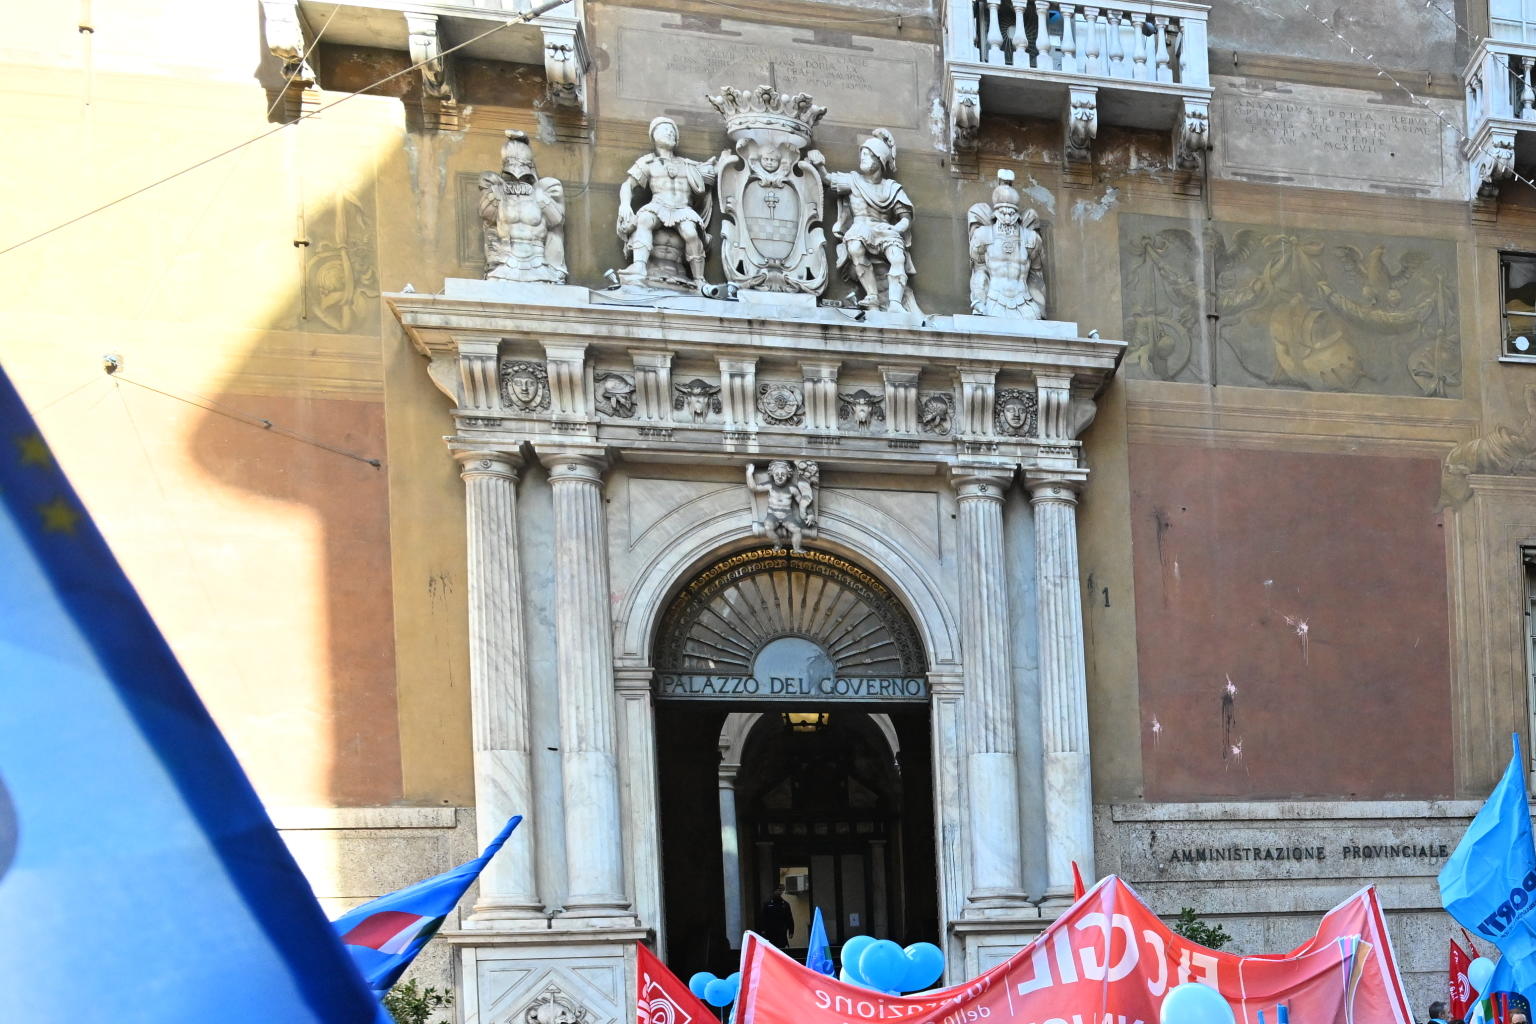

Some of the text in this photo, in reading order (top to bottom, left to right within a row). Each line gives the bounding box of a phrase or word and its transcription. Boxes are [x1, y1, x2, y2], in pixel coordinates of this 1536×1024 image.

[1328, 108, 1374, 121] DORIA
[663, 676, 921, 697] PALAZZO DEL GOVERNO
[1169, 845, 1449, 862] AMMINISTRAZIONE PROVINCIALE
